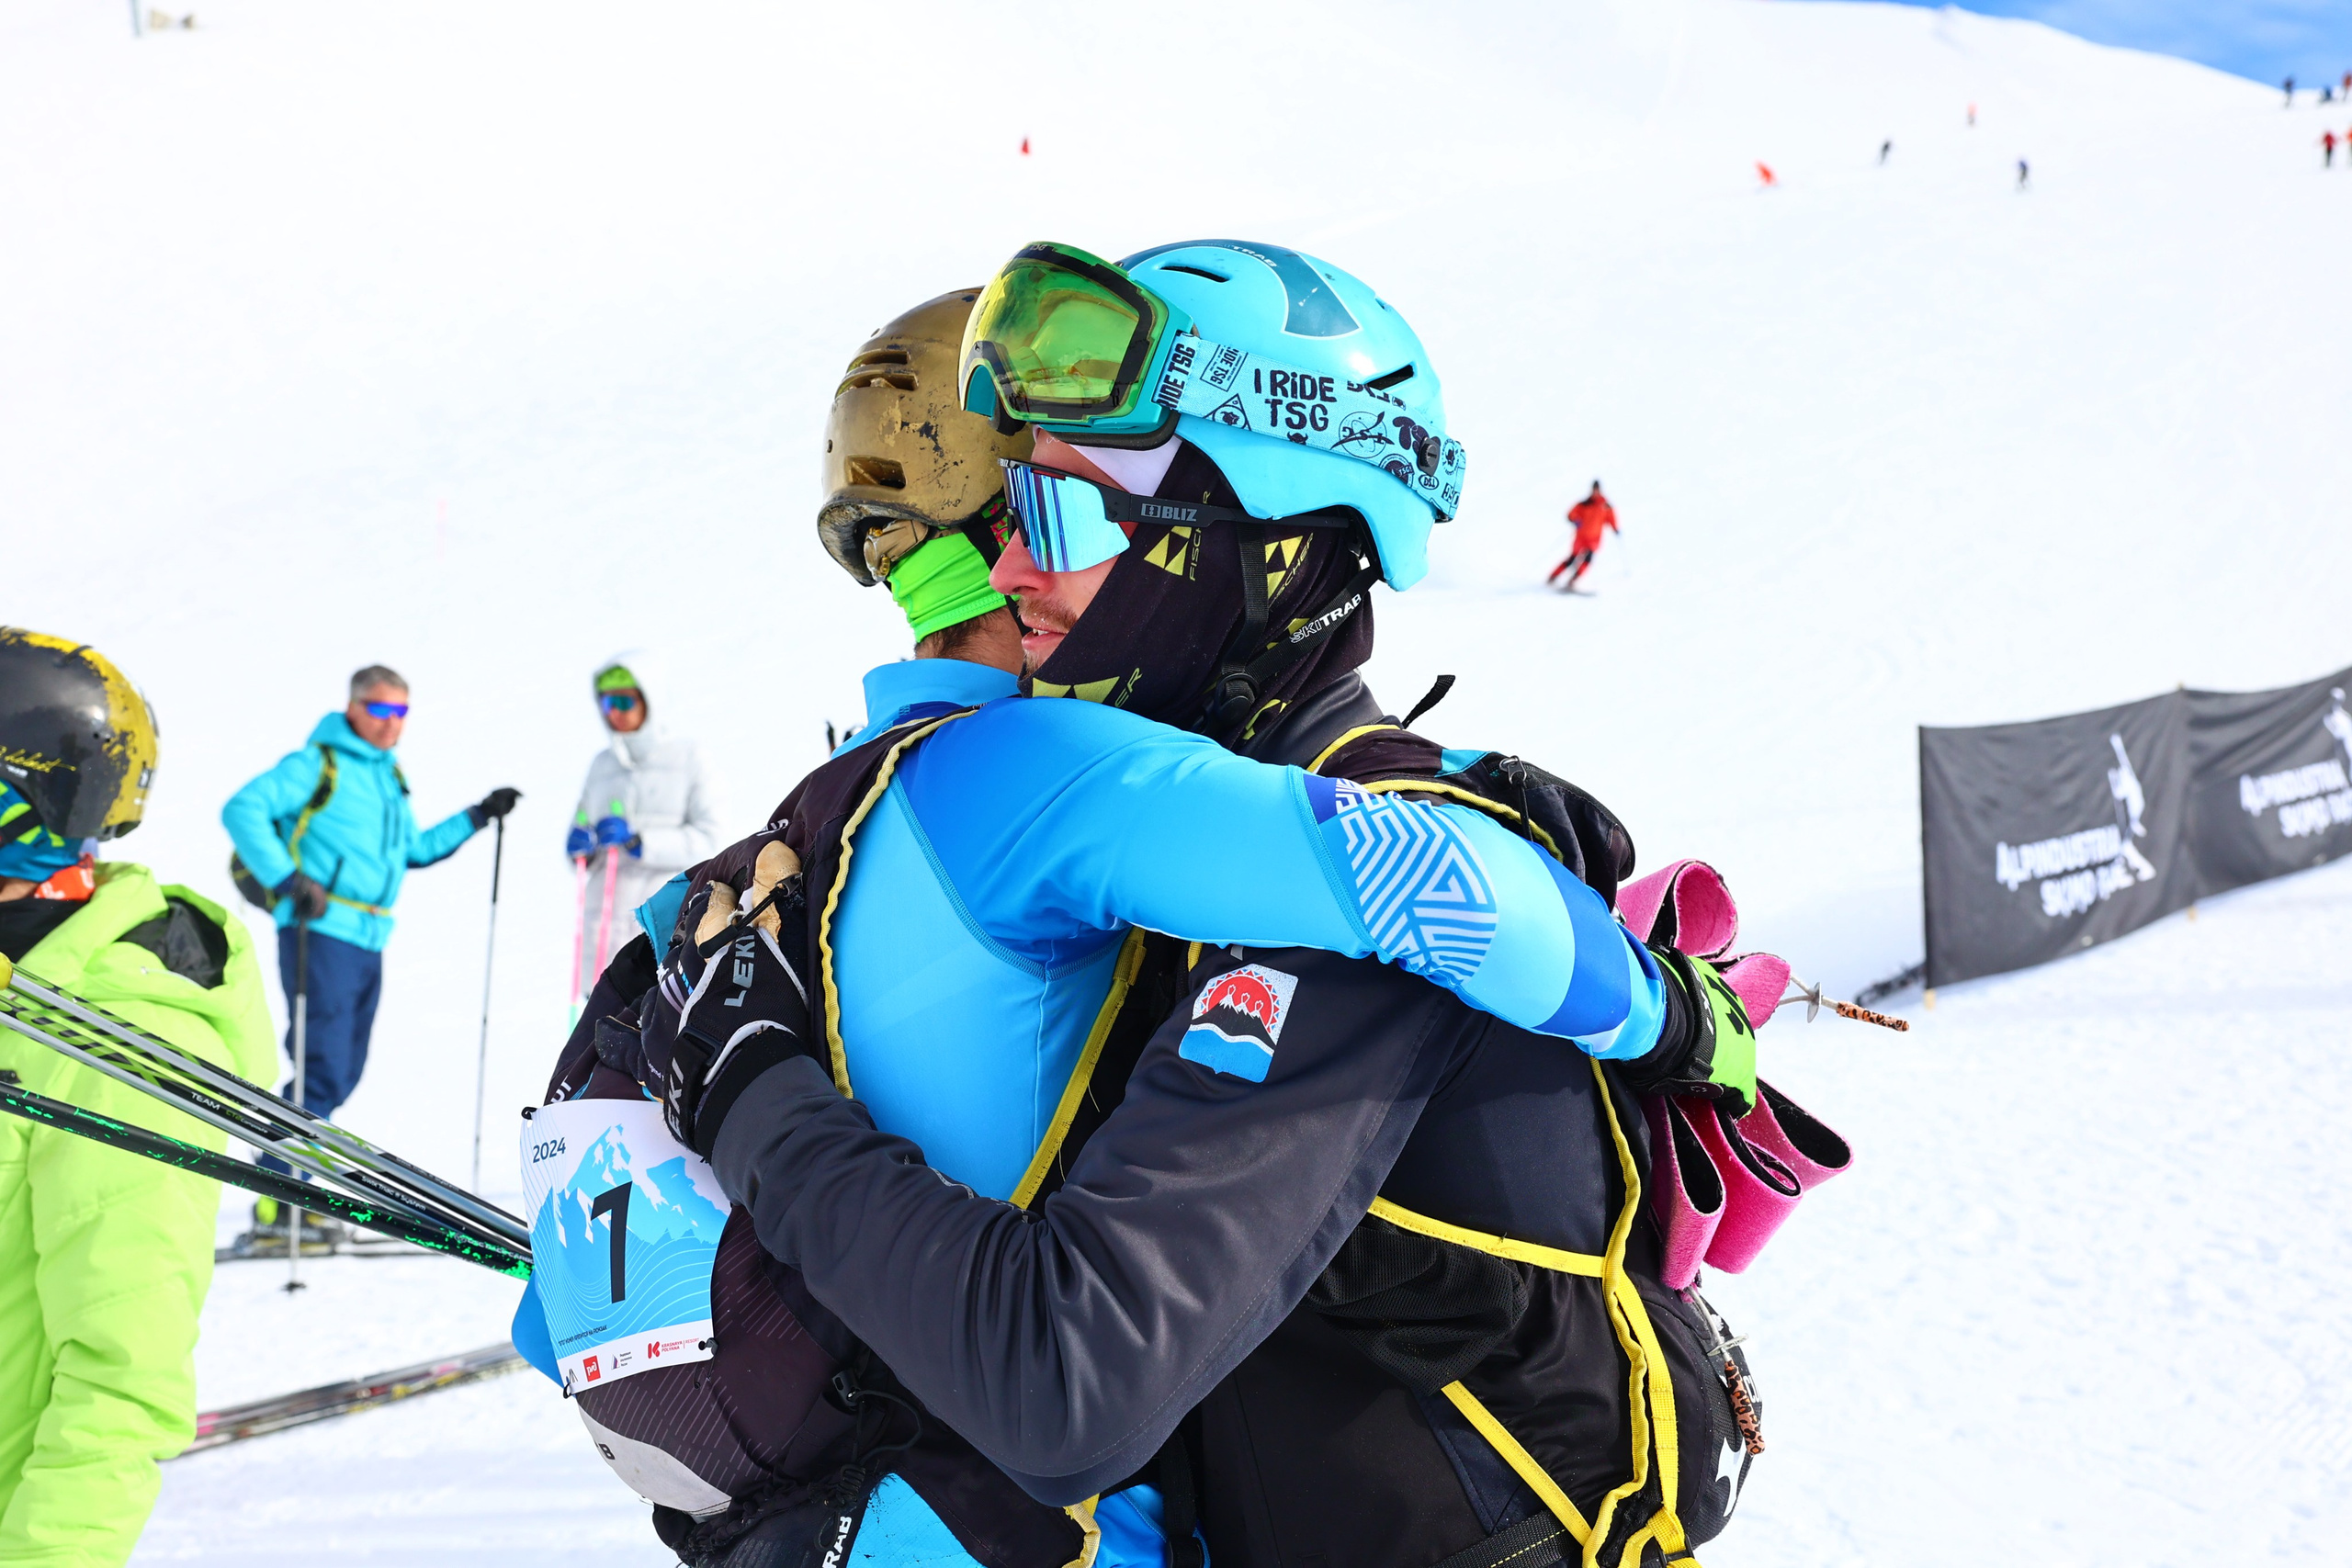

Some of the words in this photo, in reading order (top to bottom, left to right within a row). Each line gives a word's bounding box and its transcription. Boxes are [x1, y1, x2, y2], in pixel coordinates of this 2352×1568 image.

[1168, 343, 1196, 376] TSG
[1254, 367, 1262, 394] I
[1264, 398, 1329, 432] TSG
[1161, 505, 1197, 522] BLIZ
[724, 934, 755, 1008] LEKI
[191, 1091, 220, 1111] TEAM
[668, 1057, 684, 1141] EKI
[533, 1137, 567, 1164] 2024
[591, 1181, 633, 1304] 1
